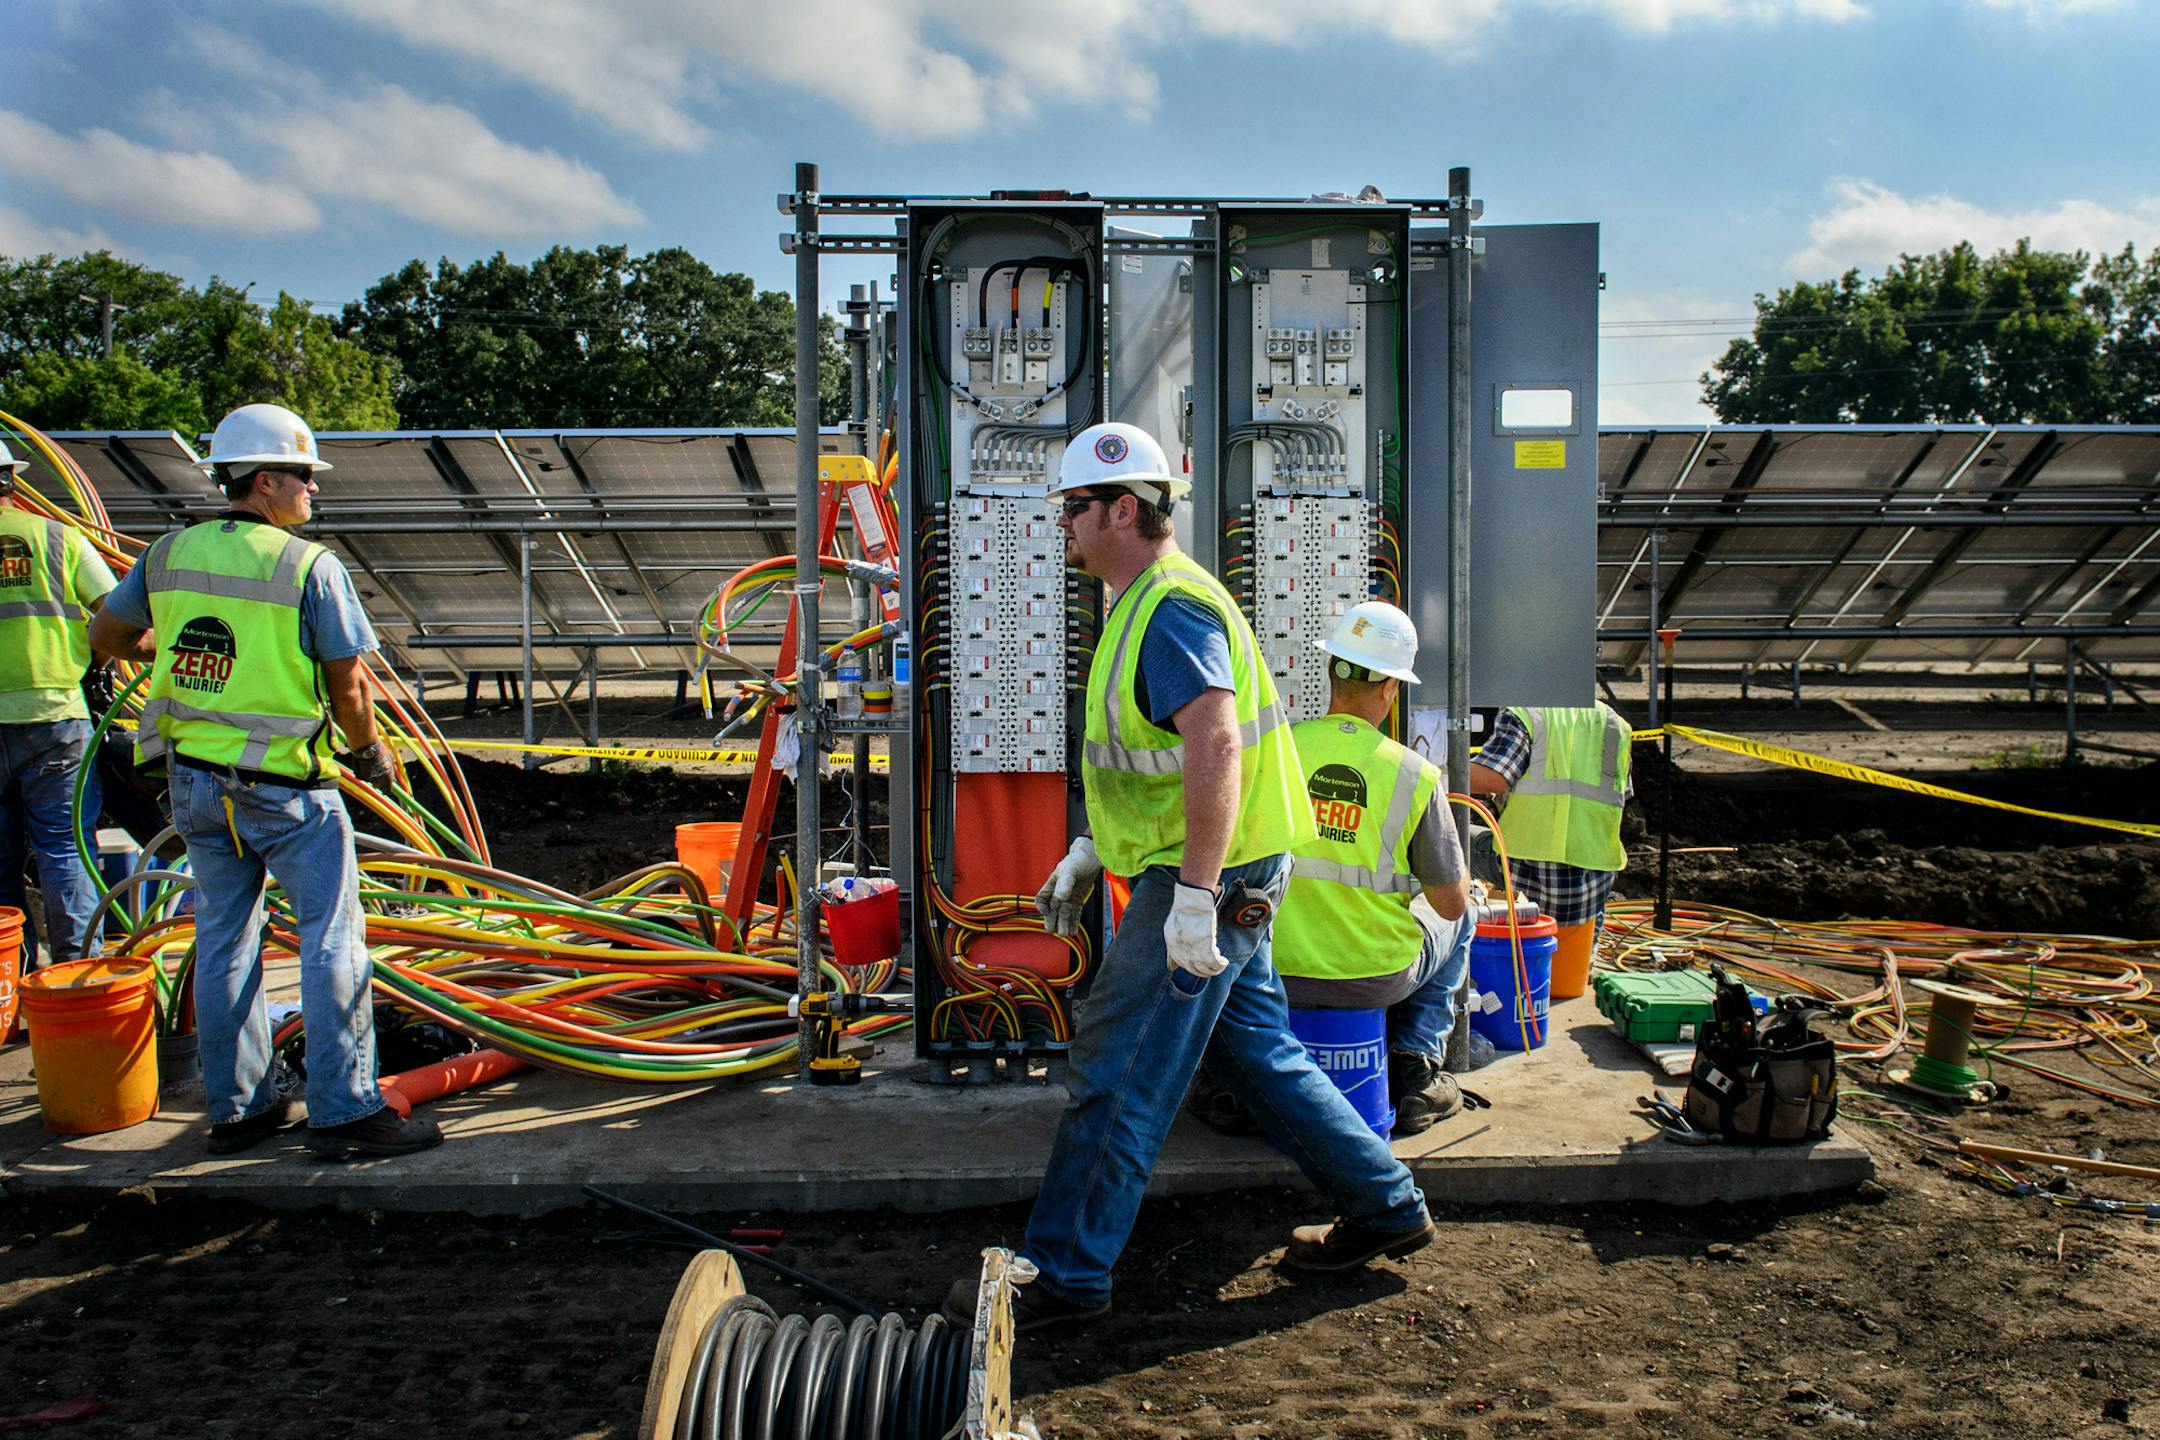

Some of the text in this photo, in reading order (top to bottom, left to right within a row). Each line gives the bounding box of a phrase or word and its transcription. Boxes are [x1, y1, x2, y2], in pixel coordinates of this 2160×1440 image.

[3, 558, 31, 576] RO
[1, 577, 32, 588] URIES
[184, 627, 229, 640] Mortenson
[171, 650, 233, 682] ZERO
[174, 675, 226, 694] INJURIES
[1314, 774, 1360, 788] Mortenson
[1311, 798, 1362, 831] ERO
[1318, 823, 1357, 843] JURIES
